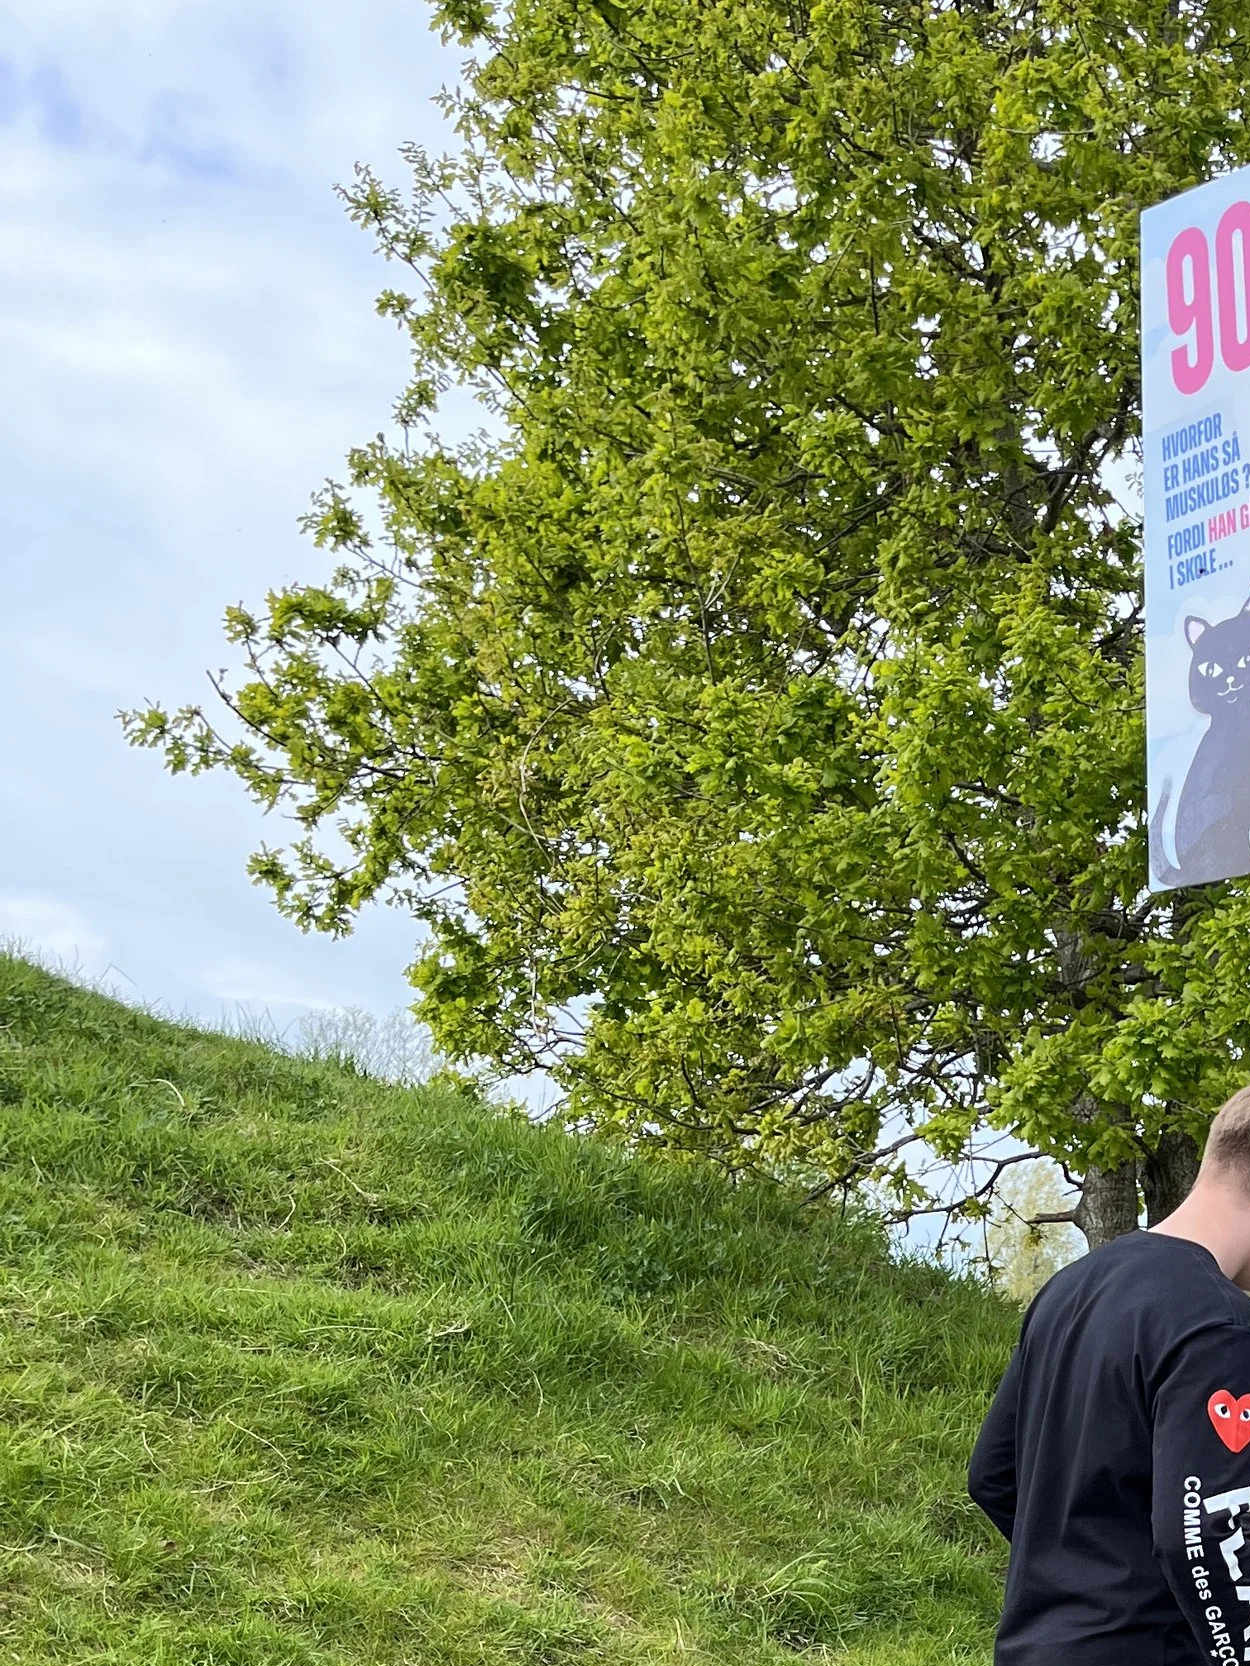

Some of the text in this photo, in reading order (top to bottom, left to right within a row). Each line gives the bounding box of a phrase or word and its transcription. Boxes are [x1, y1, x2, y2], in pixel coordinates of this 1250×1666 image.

[1162, 412, 1222, 462] HVORFOR
[1163, 431, 1241, 492] ER HANS SÅ
[1167, 521, 1205, 560] FORDI
[1208, 508, 1237, 543] HAN
[1169, 565, 1175, 590] I
[1183, 1475, 1205, 1560] COMME
[1191, 1565, 1212, 1601] des
